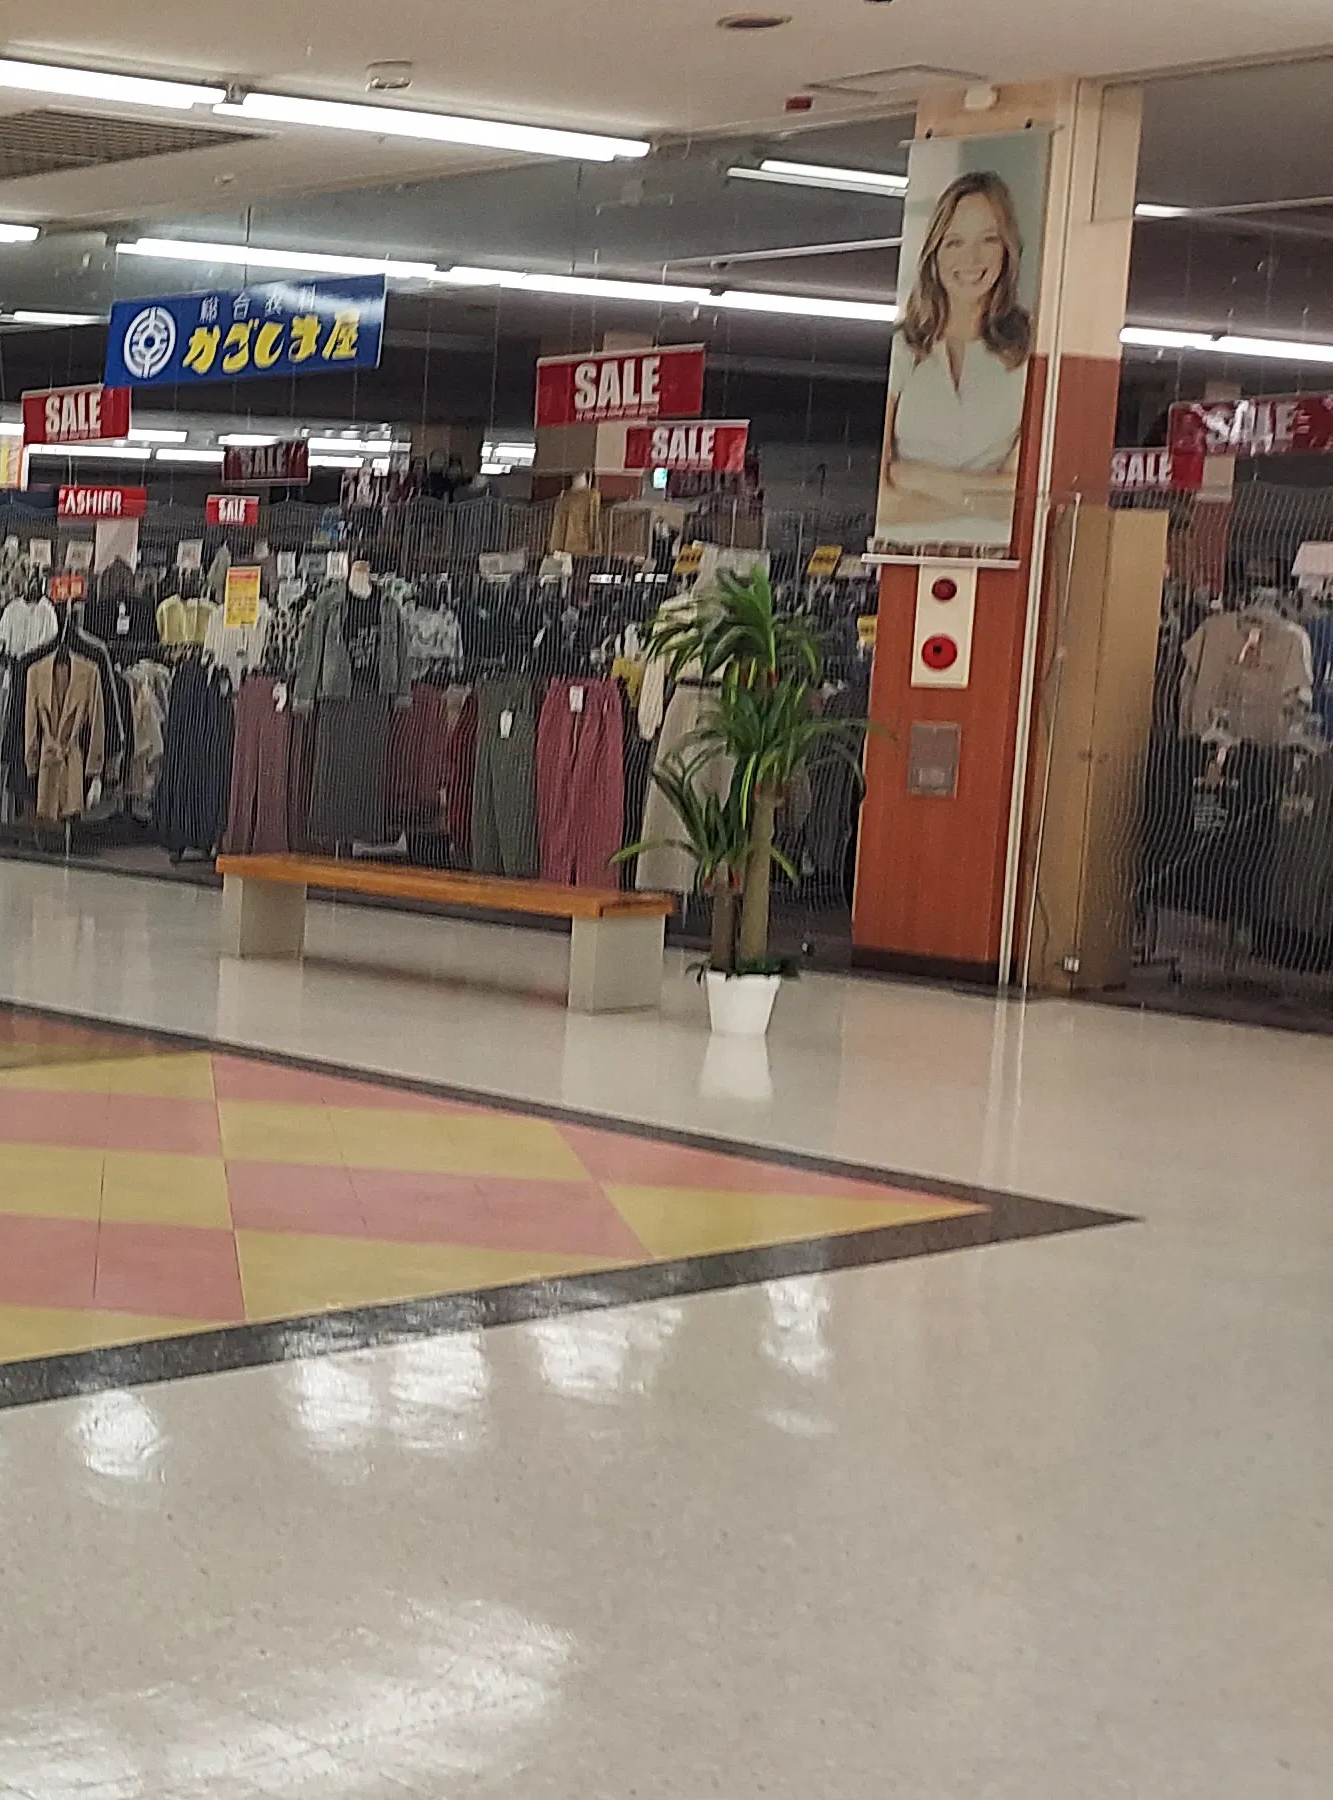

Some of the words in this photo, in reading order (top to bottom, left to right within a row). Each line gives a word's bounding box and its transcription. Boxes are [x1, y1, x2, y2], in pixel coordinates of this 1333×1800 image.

[183, 307, 362, 374] かごしま屋
[574, 357, 661, 410] SALE
[45, 391, 101, 434] SALE
[1204, 400, 1300, 447] SALE
[239, 447, 286, 478] SALE
[651, 427, 715, 466] SALE
[1111, 452, 1172, 487] SALE
[218, 498, 245, 521] SALE
